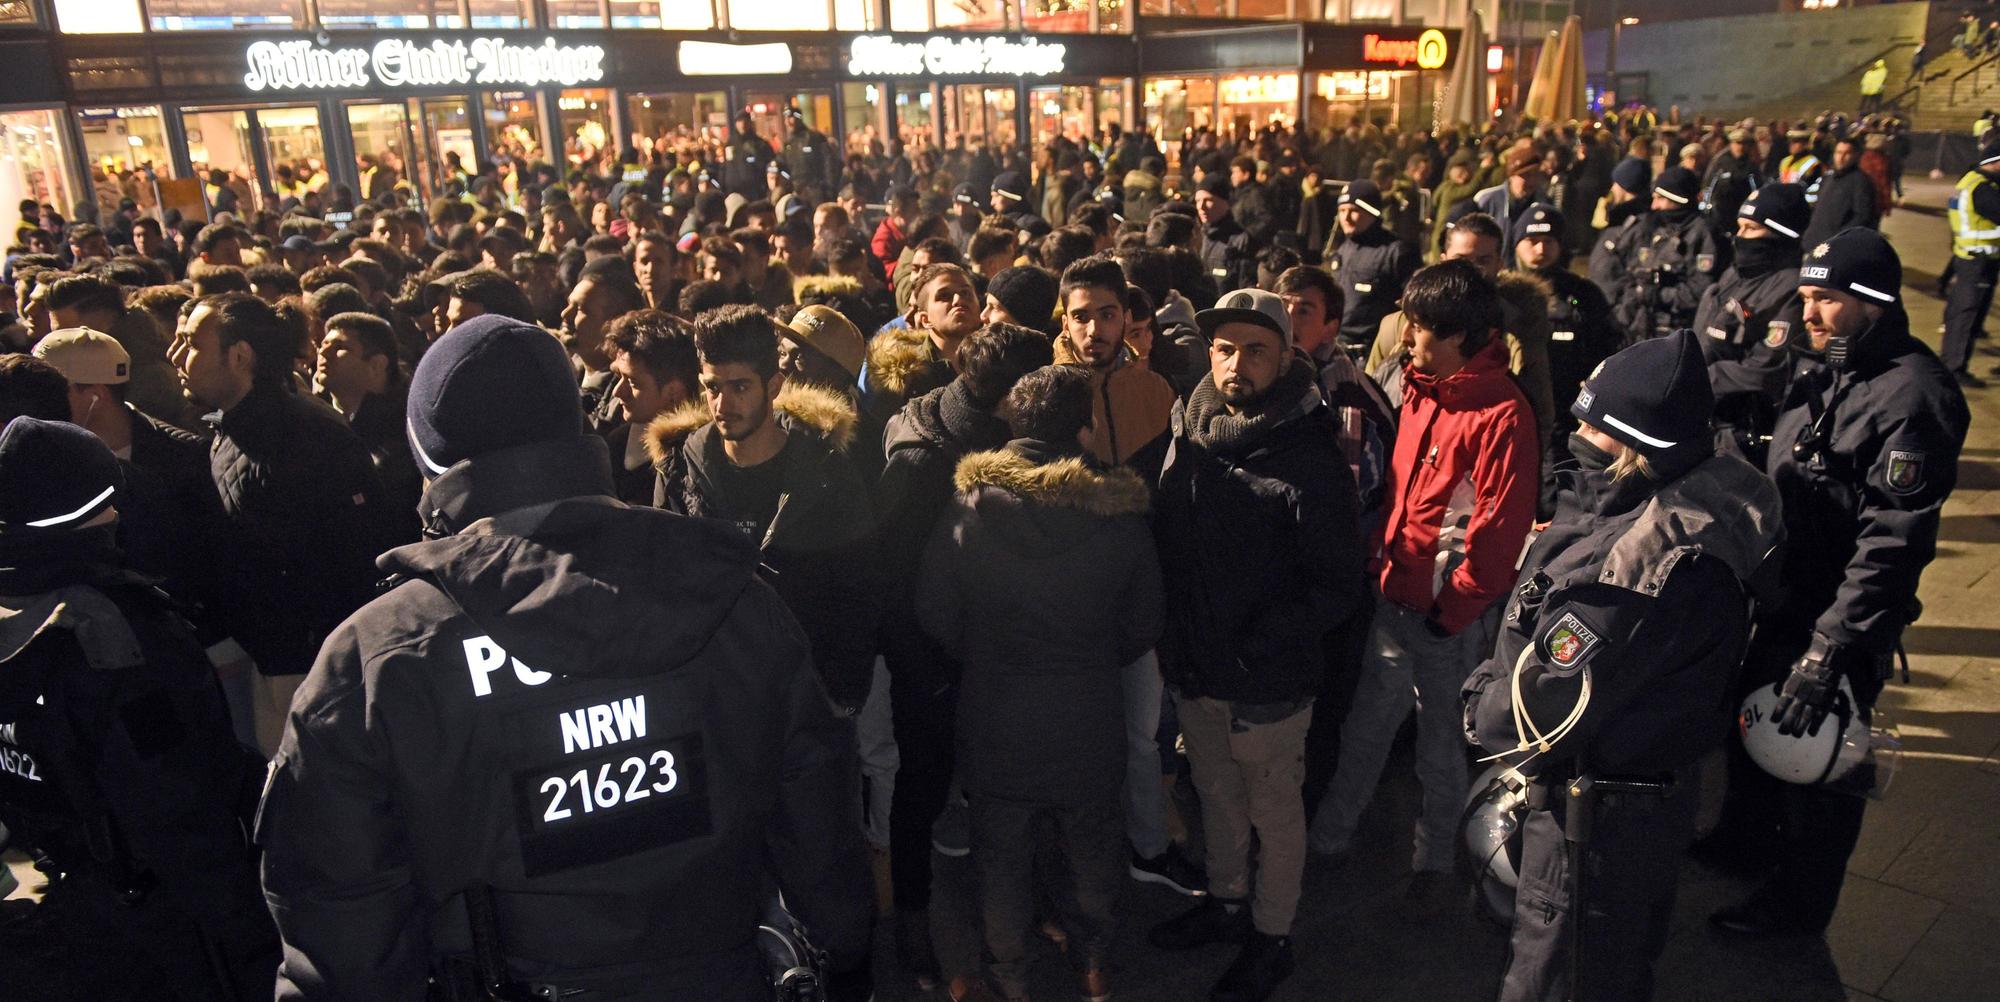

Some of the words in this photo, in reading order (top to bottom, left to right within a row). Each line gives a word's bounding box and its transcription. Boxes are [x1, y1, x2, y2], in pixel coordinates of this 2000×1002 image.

[244, 39, 370, 91] Kölner
[371, 36, 605, 87] Stadt-Anzeiger
[1364, 34, 1418, 67] Kamps
[1562, 614, 1595, 645] POLIZEI
[560, 694, 647, 754] NRW
[539, 749, 678, 823] 21623
